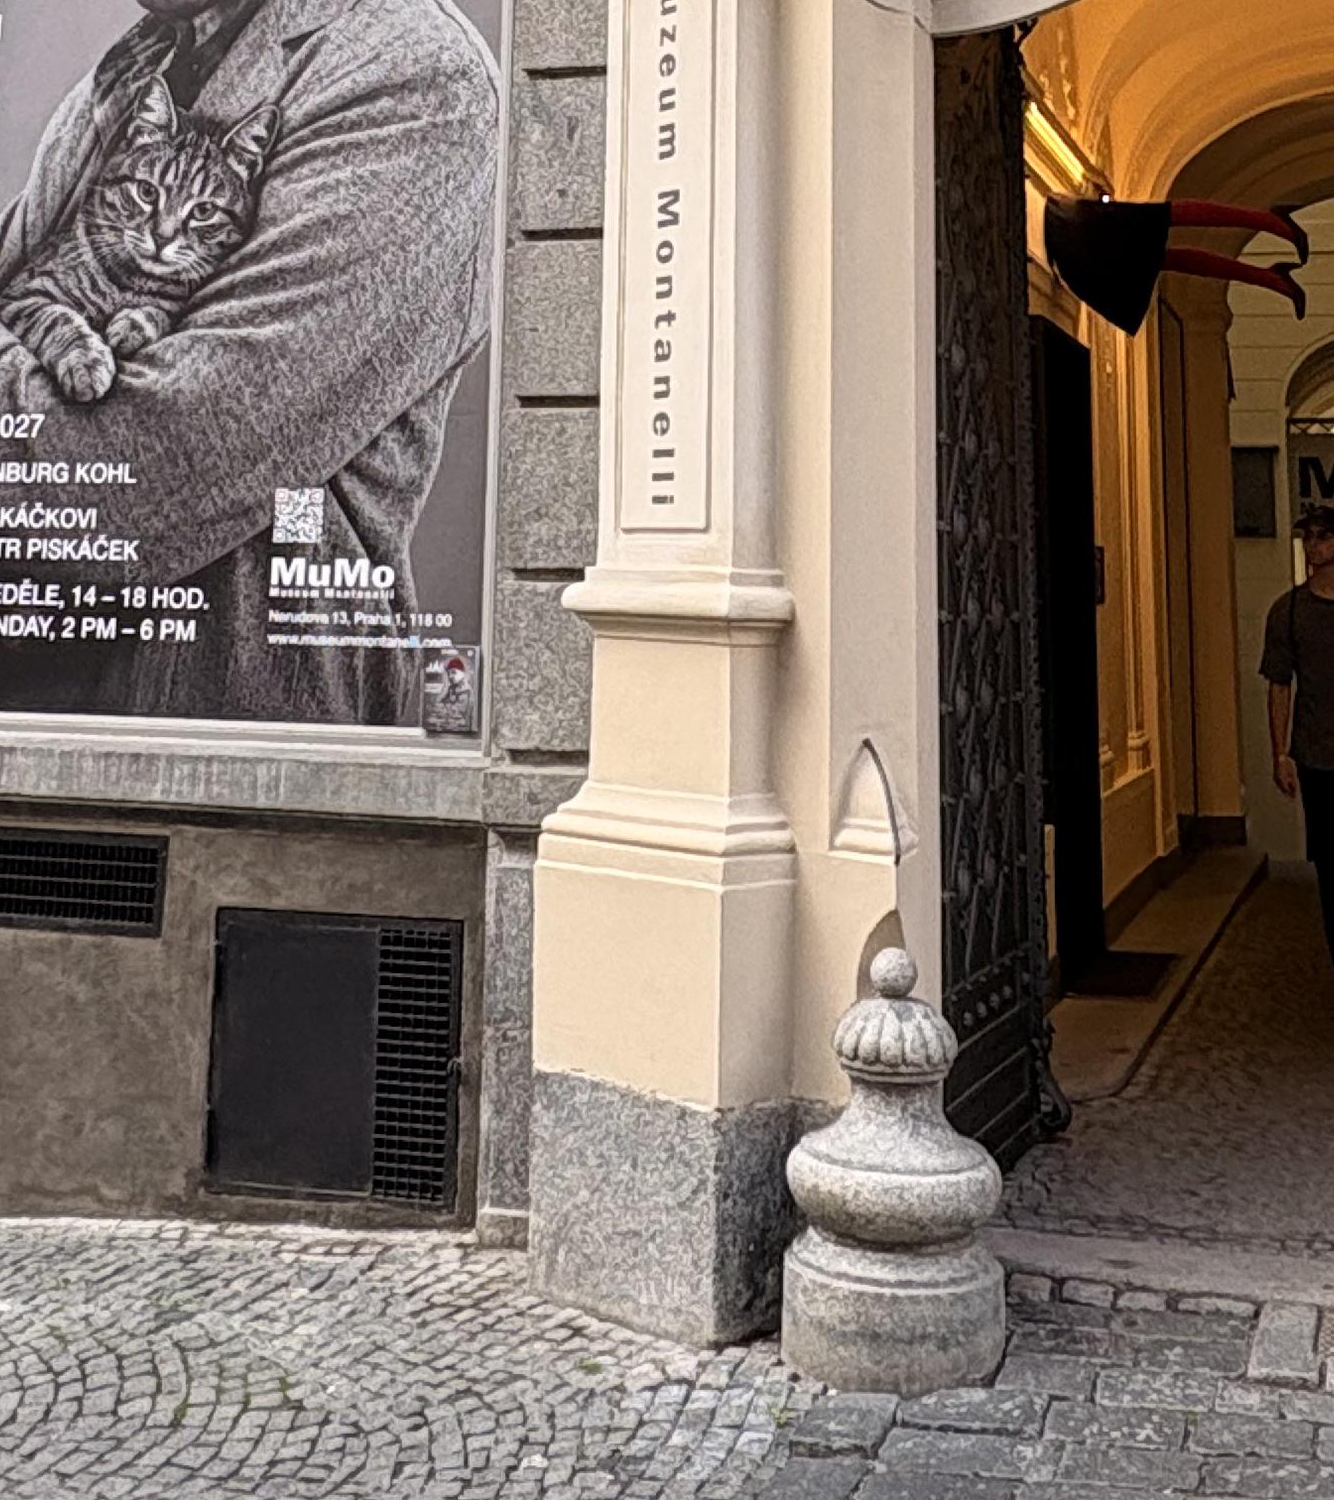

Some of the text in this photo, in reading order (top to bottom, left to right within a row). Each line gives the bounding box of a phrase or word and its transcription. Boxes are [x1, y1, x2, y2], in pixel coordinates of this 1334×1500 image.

[651, 189, 681, 506] Montanelli
[74, 462, 138, 485] KOHL
[26, 533, 141, 562] PISKÁČEK
[269, 556, 396, 589] MuMo
[71, 585, 98, 608] 14
[120, 586, 147, 609] 18
[151, 586, 211, 611] HOD.
[60, 616, 76, 639] 2
[79, 616, 117, 640] PM
[138, 617, 155, 641] 6
[158, 619, 197, 642] PM
[268, 608, 330, 625] Nerudova
[332, 611, 352, 627] 13,
[354, 611, 392, 626] Praha
[410, 612, 433, 628] 118
[434, 612, 453, 628] 00
